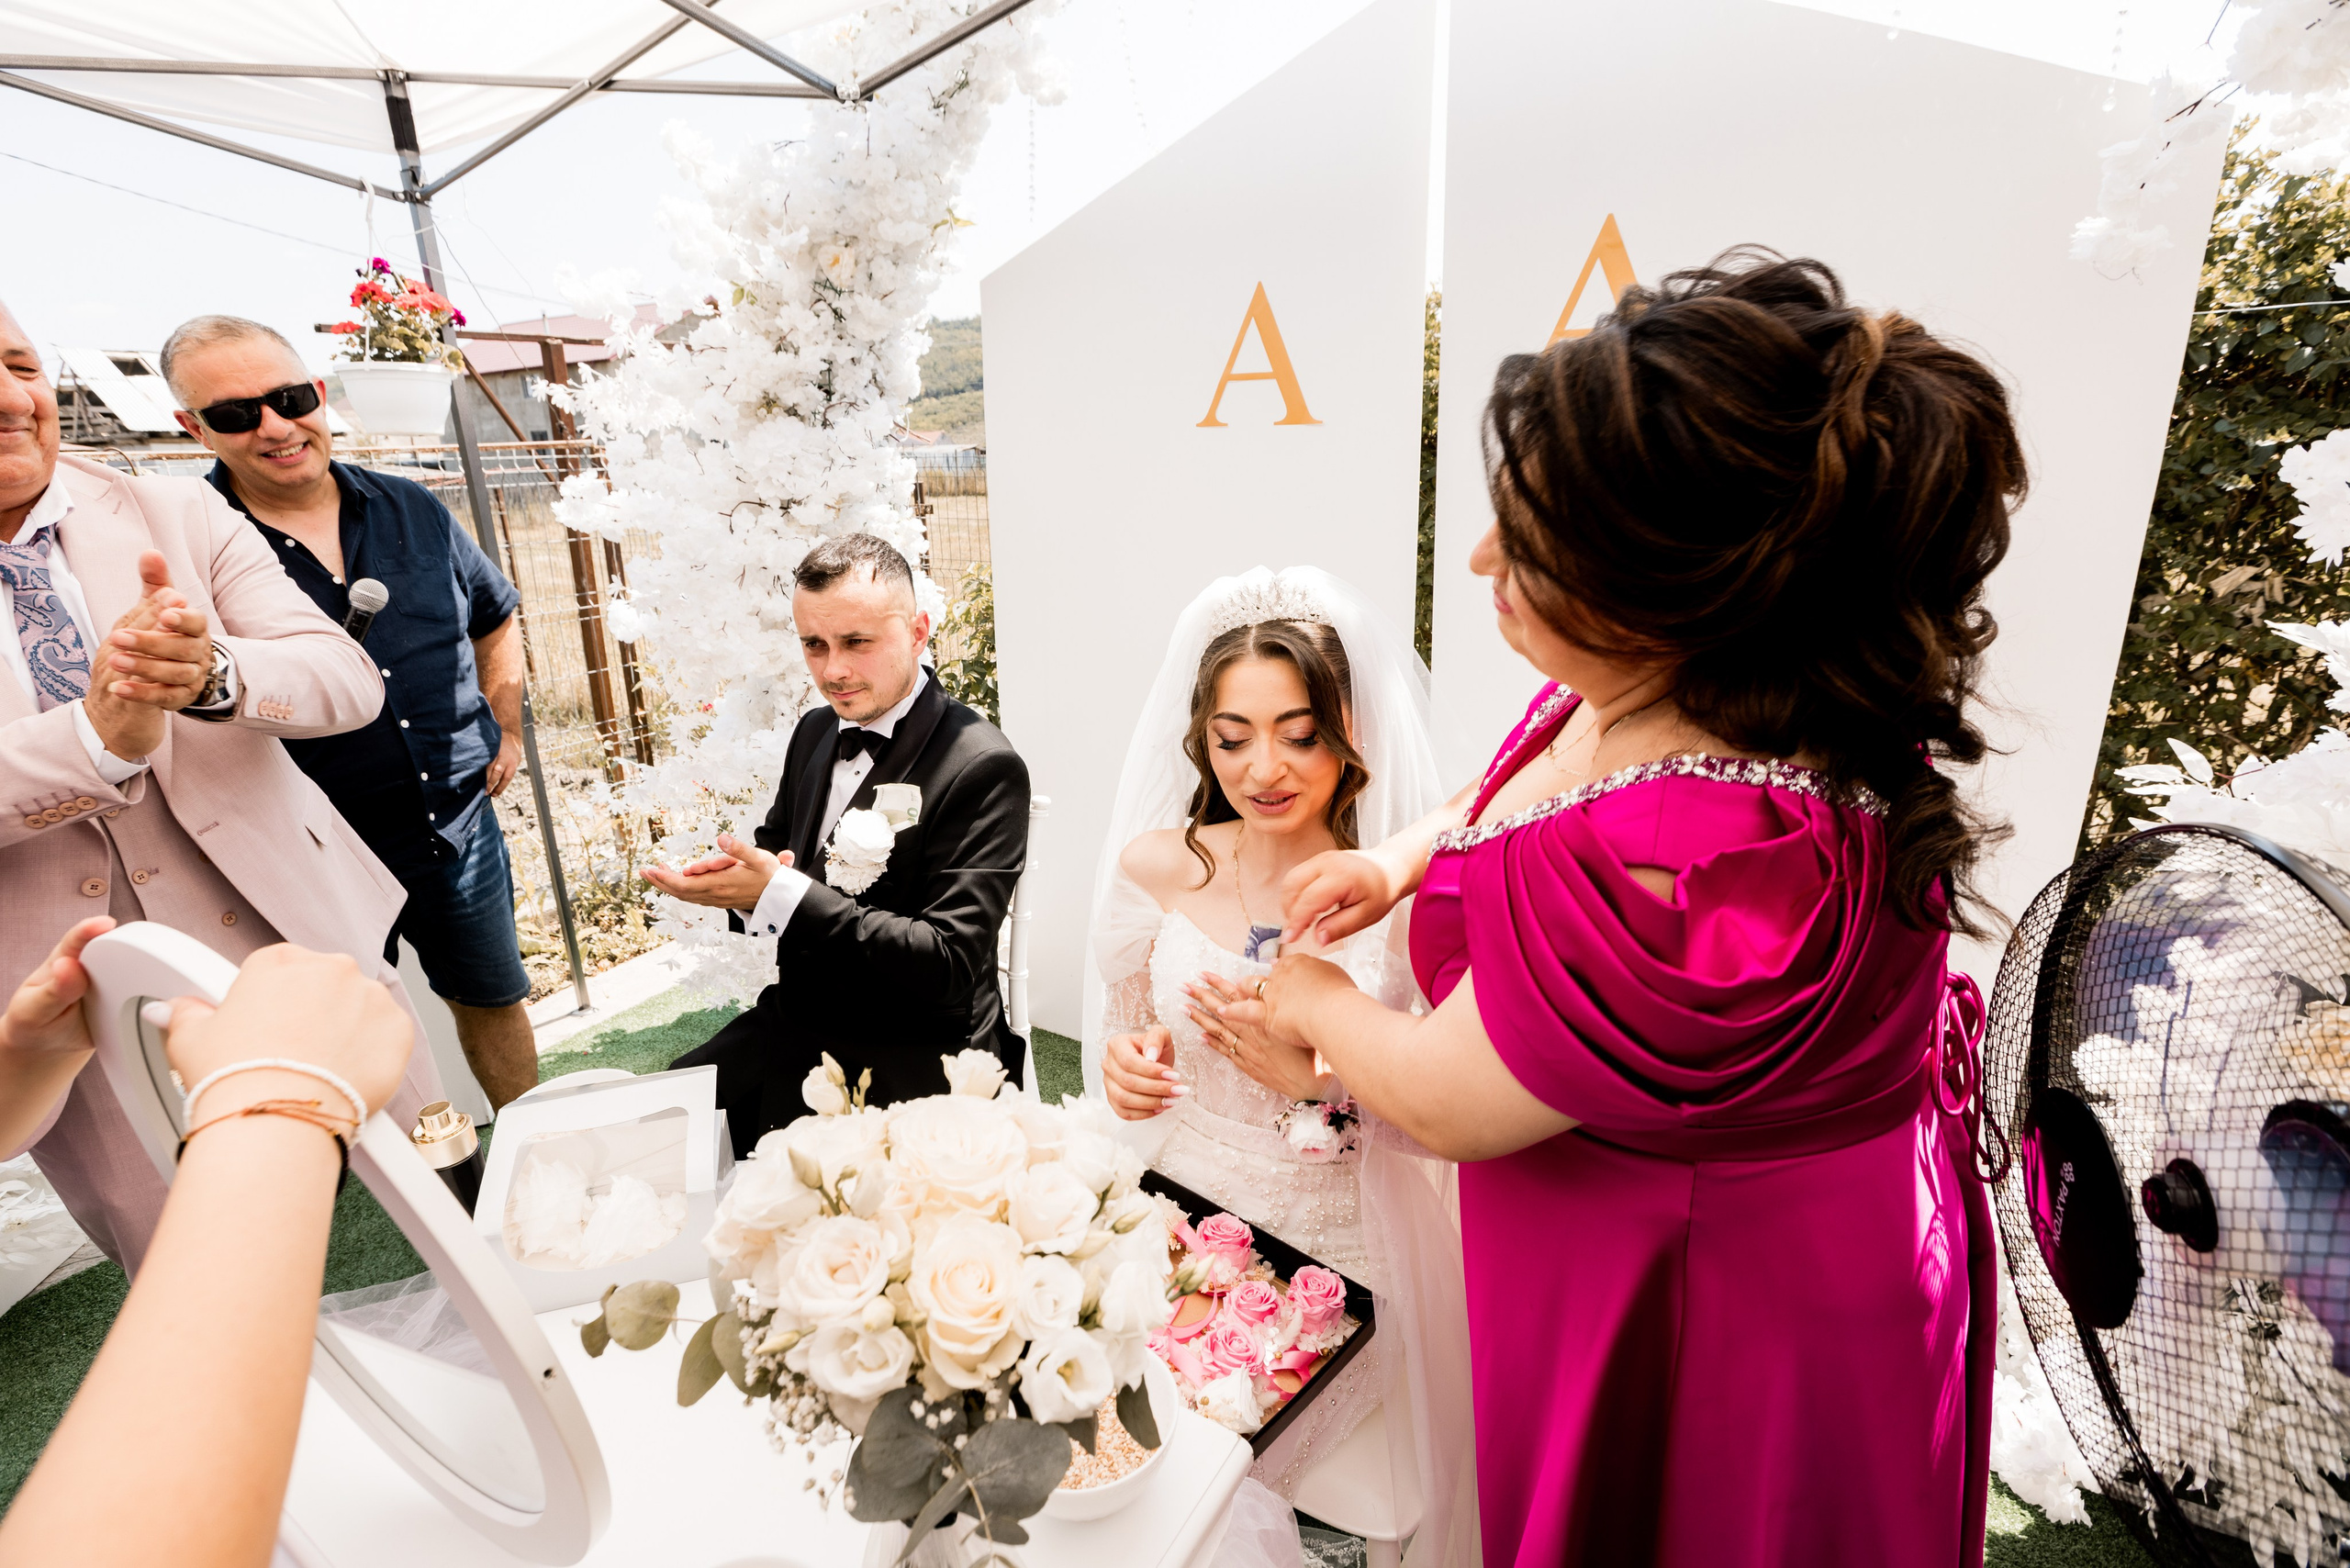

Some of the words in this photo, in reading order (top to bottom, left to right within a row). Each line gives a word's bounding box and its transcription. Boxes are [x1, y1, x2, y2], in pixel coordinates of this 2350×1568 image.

[1544, 213, 1639, 353] A
[1196, 281, 1323, 428] A
[2053, 1181, 2069, 1248] PAXTON
